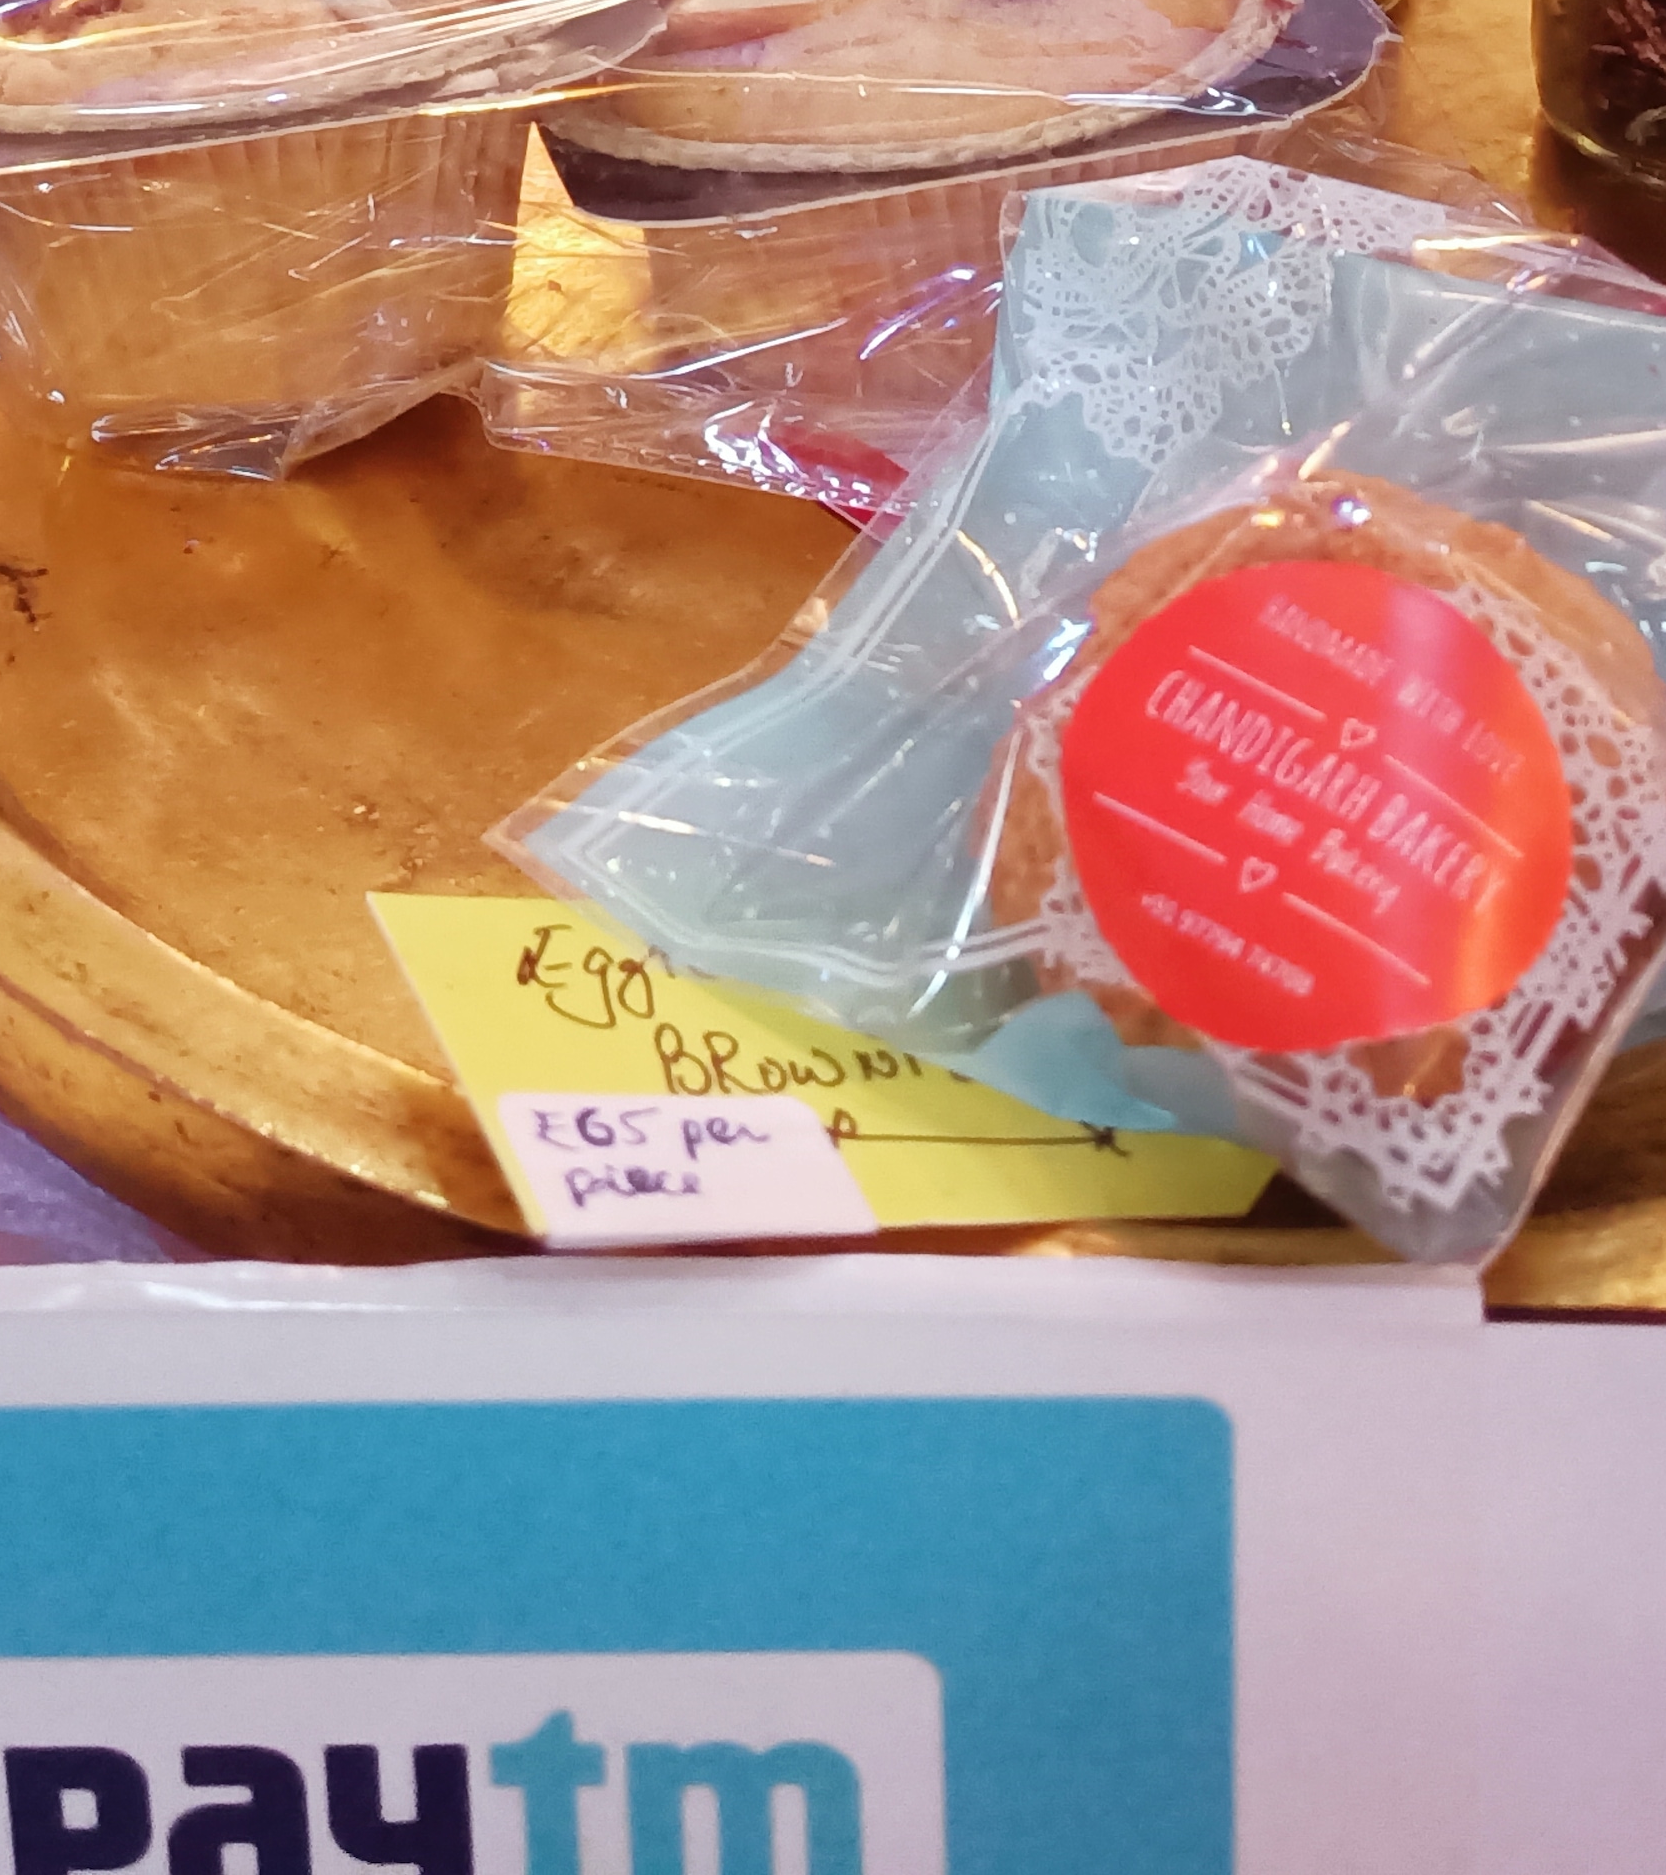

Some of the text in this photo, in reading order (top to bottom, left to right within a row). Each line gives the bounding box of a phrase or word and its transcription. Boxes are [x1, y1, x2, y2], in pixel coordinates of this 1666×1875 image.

[1144, 668, 1383, 822] CHANDIGARH
[654, 1022, 975, 1096] BROWNI
[680, 1115, 773, 1162] per
